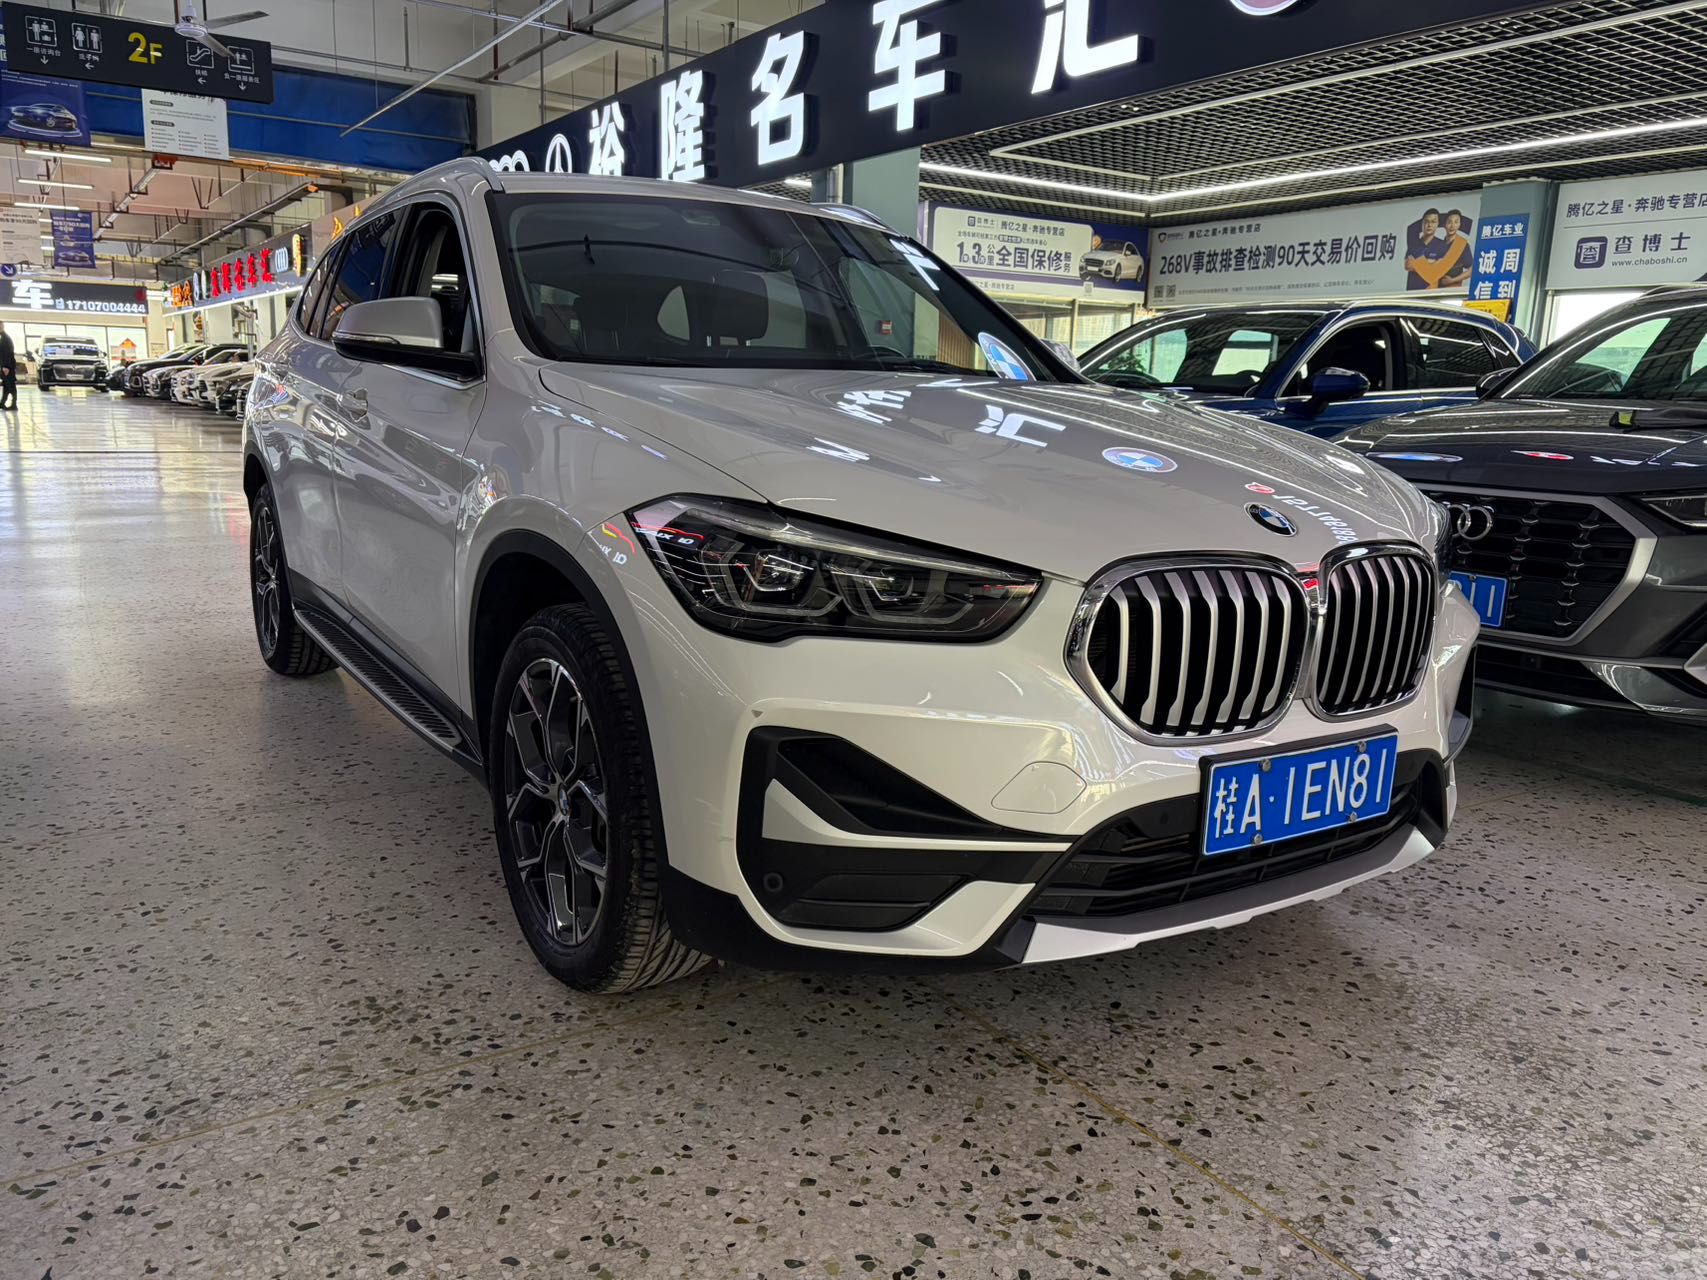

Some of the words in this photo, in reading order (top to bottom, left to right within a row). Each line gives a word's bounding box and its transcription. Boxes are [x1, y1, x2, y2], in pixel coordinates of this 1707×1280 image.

[127, 32, 163, 64] 2F
[1481, 223, 1524, 238] 腾亿车业
[1613, 231, 1691, 255] 查博士
[1159, 232, 1397, 276] 268V事故排查检测90天交易价回购
[1611, 256, 1688, 267] www.chaboshi.cn
[11, 279, 54, 309] 车
[66, 299, 146, 313] 17107004444
[1214, 748, 1387, 839] 桂A·1EN81
